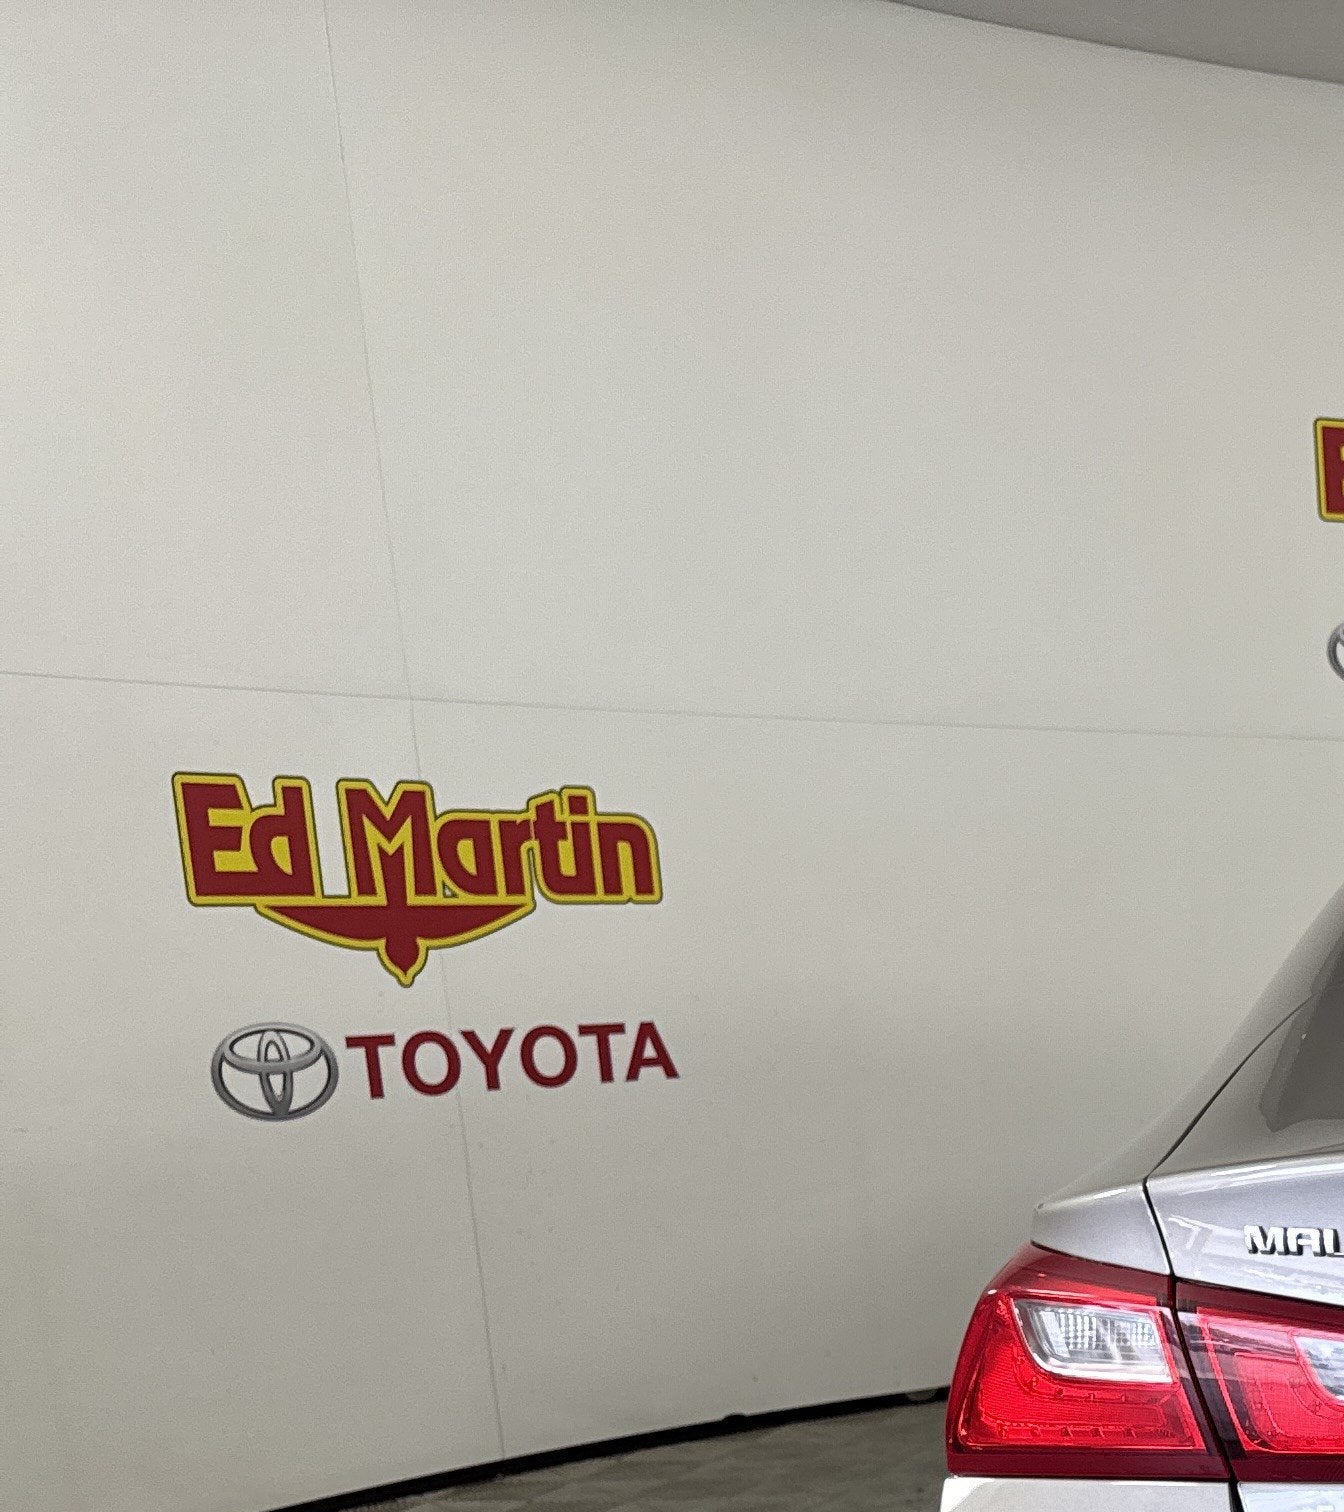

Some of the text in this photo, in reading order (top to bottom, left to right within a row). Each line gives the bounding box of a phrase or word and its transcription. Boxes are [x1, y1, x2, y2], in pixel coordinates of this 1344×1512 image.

[172, 771, 662, 906] Ed Martin
[346, 1021, 679, 1100] TOYOTA
